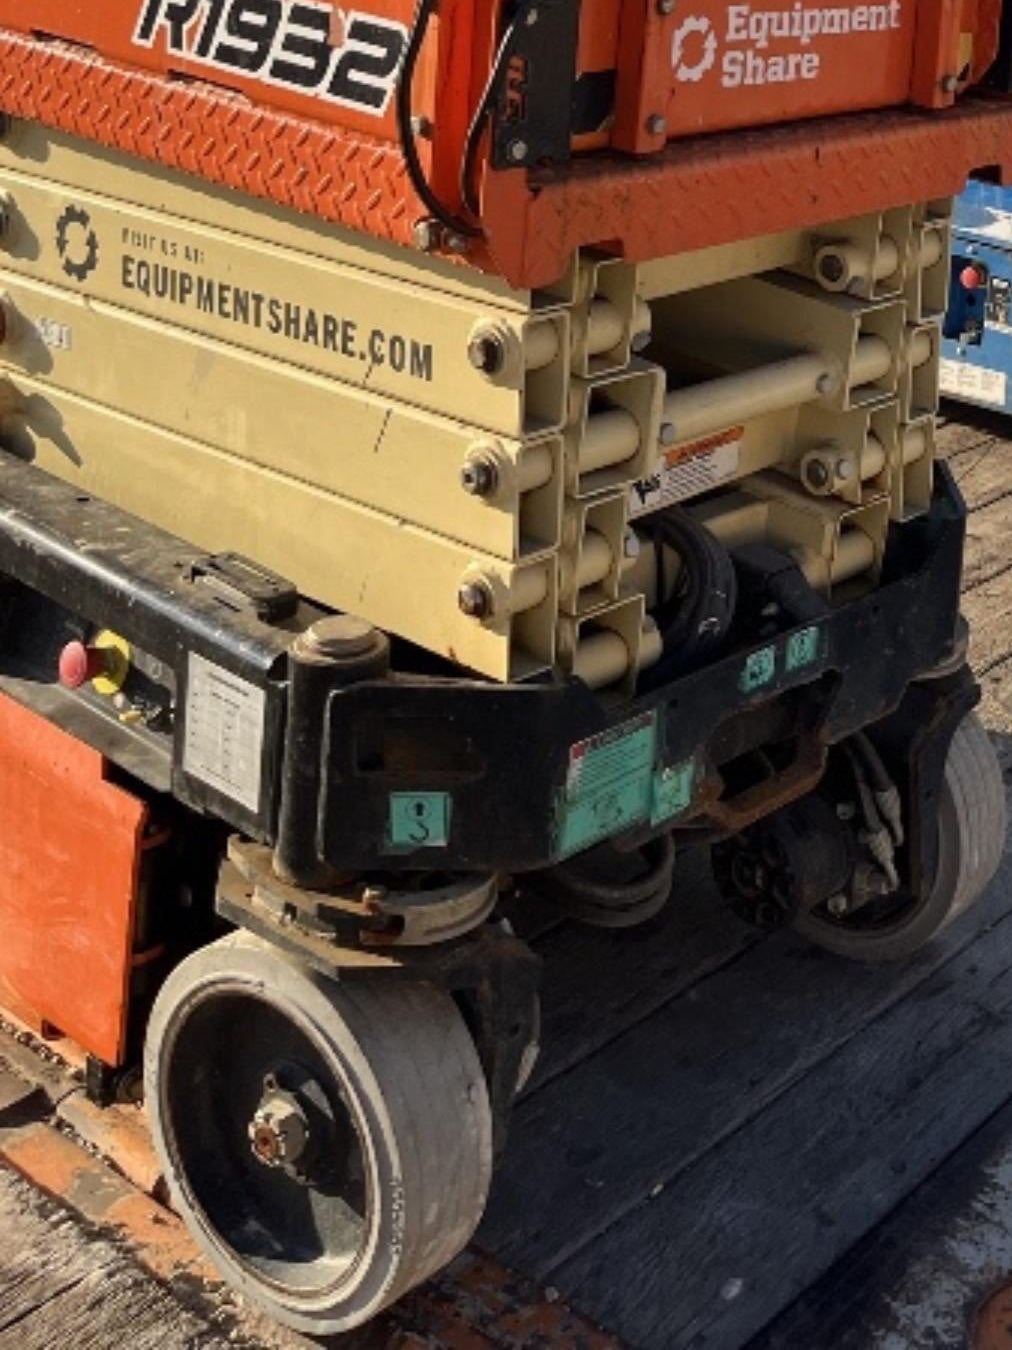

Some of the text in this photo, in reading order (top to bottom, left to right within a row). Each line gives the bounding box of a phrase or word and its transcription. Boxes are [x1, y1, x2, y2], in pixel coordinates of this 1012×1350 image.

[725, 0, 900, 48] Equipment
[721, 49, 820, 88] Share
[121, 254, 434, 382] EQUIPMENTSHARE.COM
